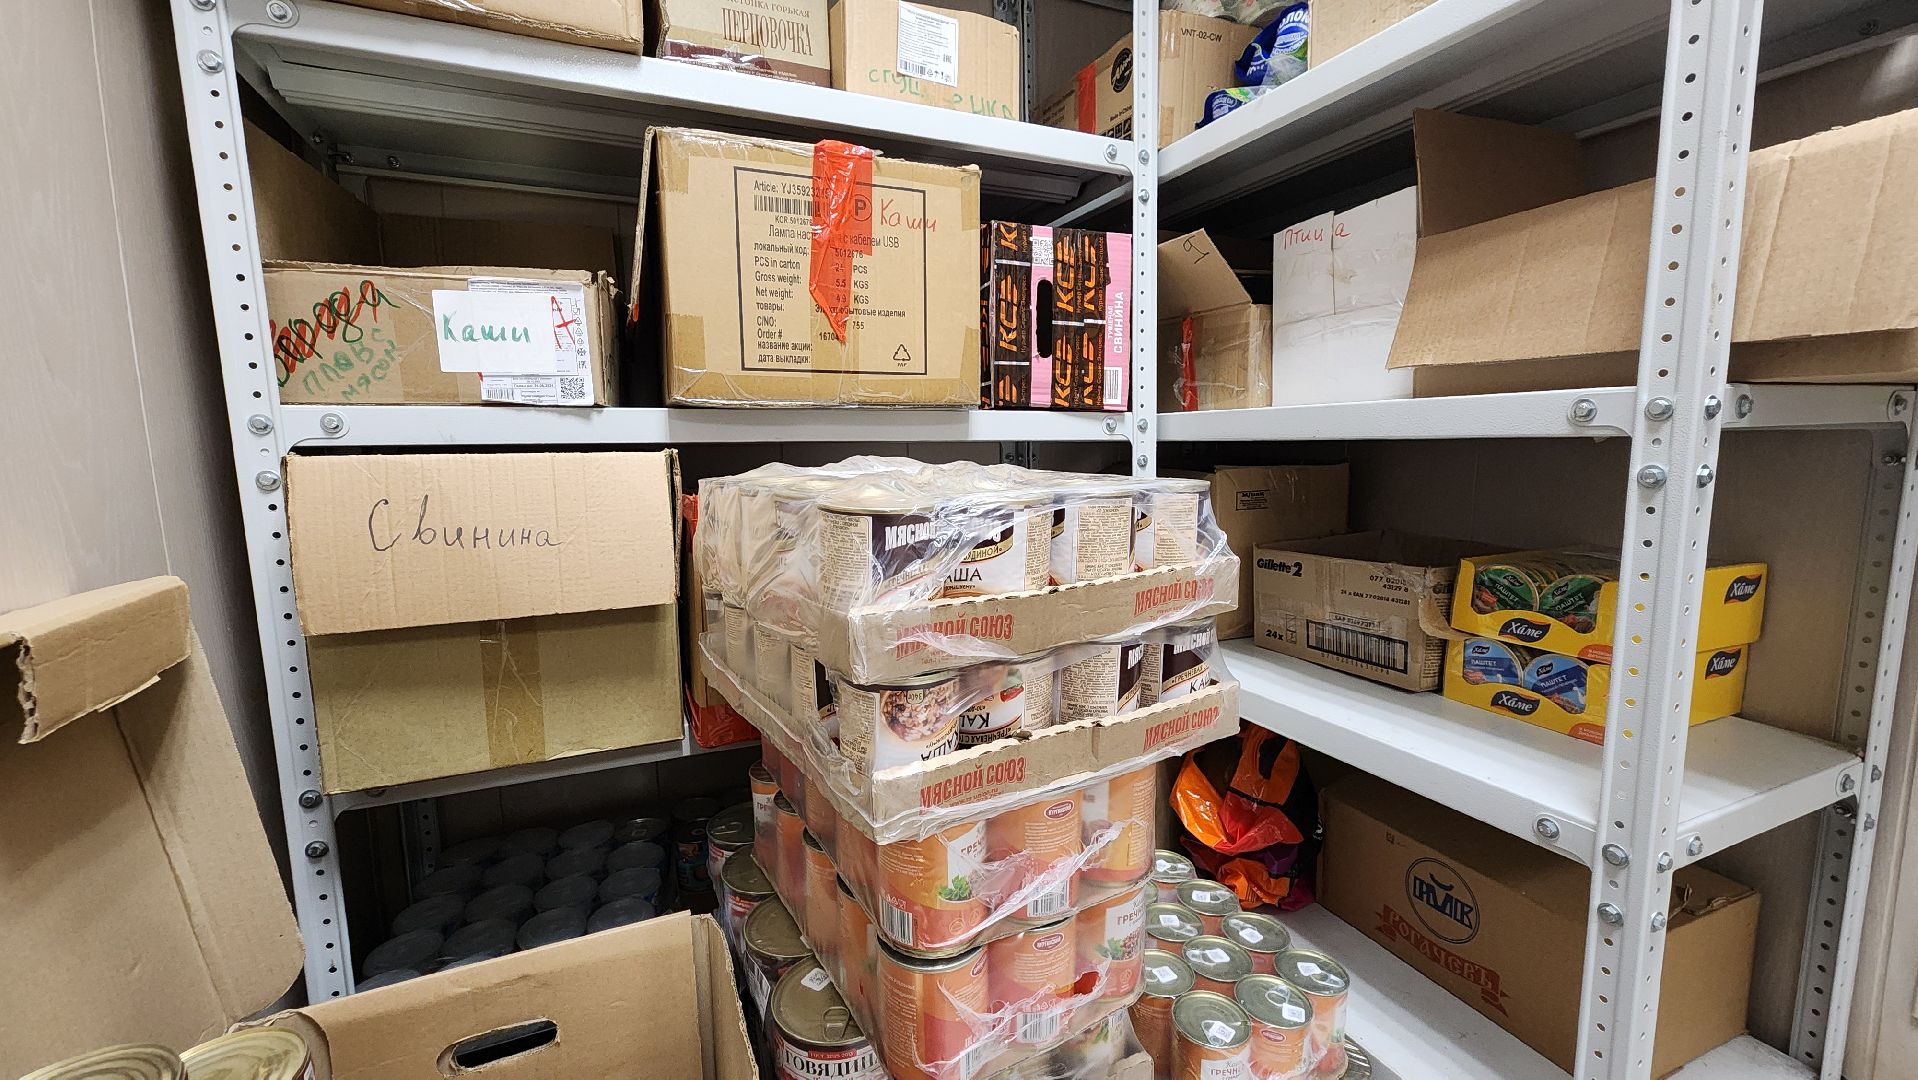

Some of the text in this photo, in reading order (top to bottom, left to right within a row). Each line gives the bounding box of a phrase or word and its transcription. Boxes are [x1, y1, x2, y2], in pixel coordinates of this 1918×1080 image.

[771, 4, 810, 18] ГОРЬКАЯ
[721, 8, 813, 56] ПЕРЦОВОЧКА
[1180, 27, 1223, 43] VNT-02-CW
[855, 198, 866, 216] P
[881, 198, 936, 232] Каши
[769, 224, 795, 239] Лампа
[849, 234, 880, 247] кабелем
[883, 236, 900, 248] USB
[1283, 222, 1351, 250] Птица
[754, 241, 793, 254] локальный
[795, 246, 809, 256] код:
[754, 256, 769, 267] PCS
[770, 257, 778, 268] in
[779, 259, 800, 270] carton
[853, 265, 868, 274] PCS
[755, 271, 776, 282] Gross
[777, 272, 802, 286] weight:
[853, 280, 869, 289] KGS
[755, 286, 767, 297] Net
[768, 288, 794, 301] weight:
[853, 294, 869, 305] KGS
[878, 308, 906, 318] изделия
[1114, 291, 1123, 353] СВИНИНА
[443, 310, 532, 343] Каши
[757, 328, 776, 339] Order
[778, 329, 783, 340] #
[757, 341, 813, 352] название акции:
[758, 354, 811, 365] дата выкладки:
[368, 494, 563, 552] Свинина
[1256, 558, 1291, 575] Gillette
[1134, 578, 1182, 617] МЯСНОЙ
[970, 613, 1014, 640] СОЮЗ
[1143, 711, 1190, 752] МЯСНОЙ
[920, 765, 983, 813] МЯСНОЙ
[986, 757, 1025, 785] СОЮЗ
[785, 1050, 878, 1078] ГОВЯДИН
